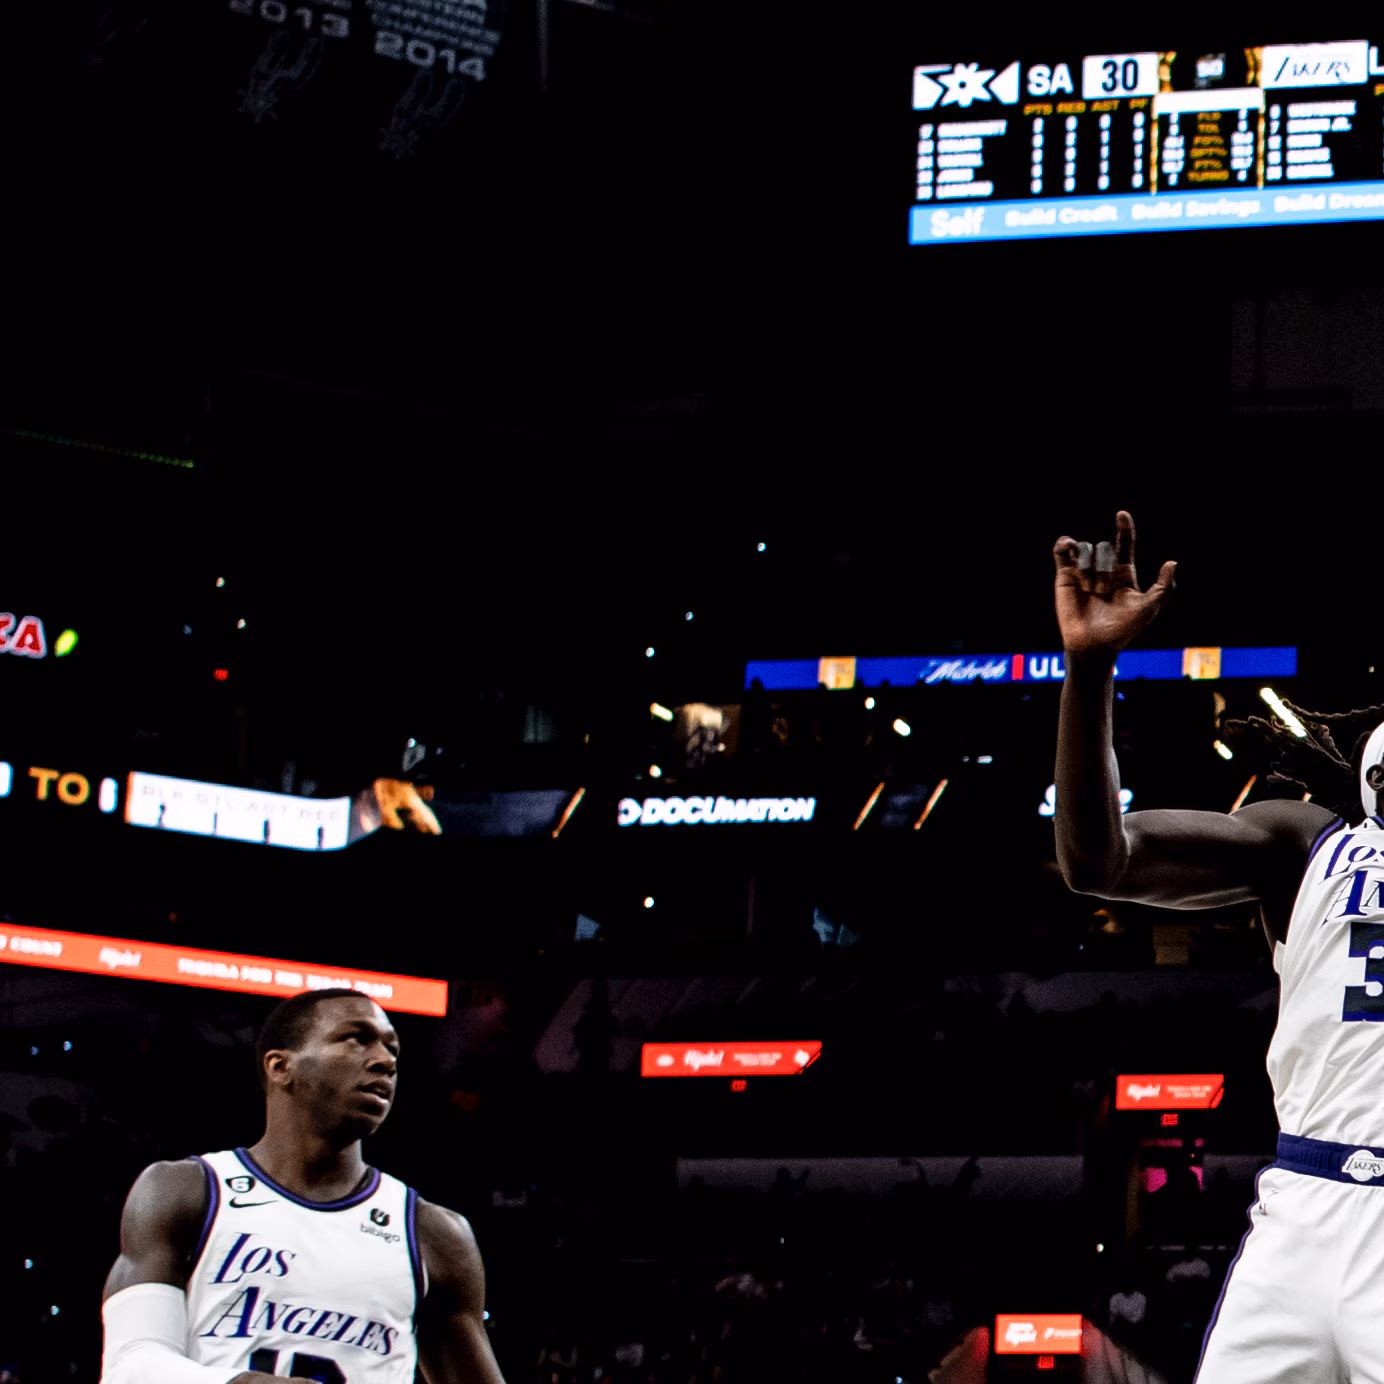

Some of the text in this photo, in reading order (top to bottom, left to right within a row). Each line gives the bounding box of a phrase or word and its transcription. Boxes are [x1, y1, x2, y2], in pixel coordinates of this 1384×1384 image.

[373, 28, 487, 82] 2014
[1027, 59, 1139, 97] SA 30
[930, 208, 984, 238] Self
[28, 766, 91, 806] TO
[640, 796, 816, 826] DOCUMATION
[360, 1223, 400, 1243] bibigo
